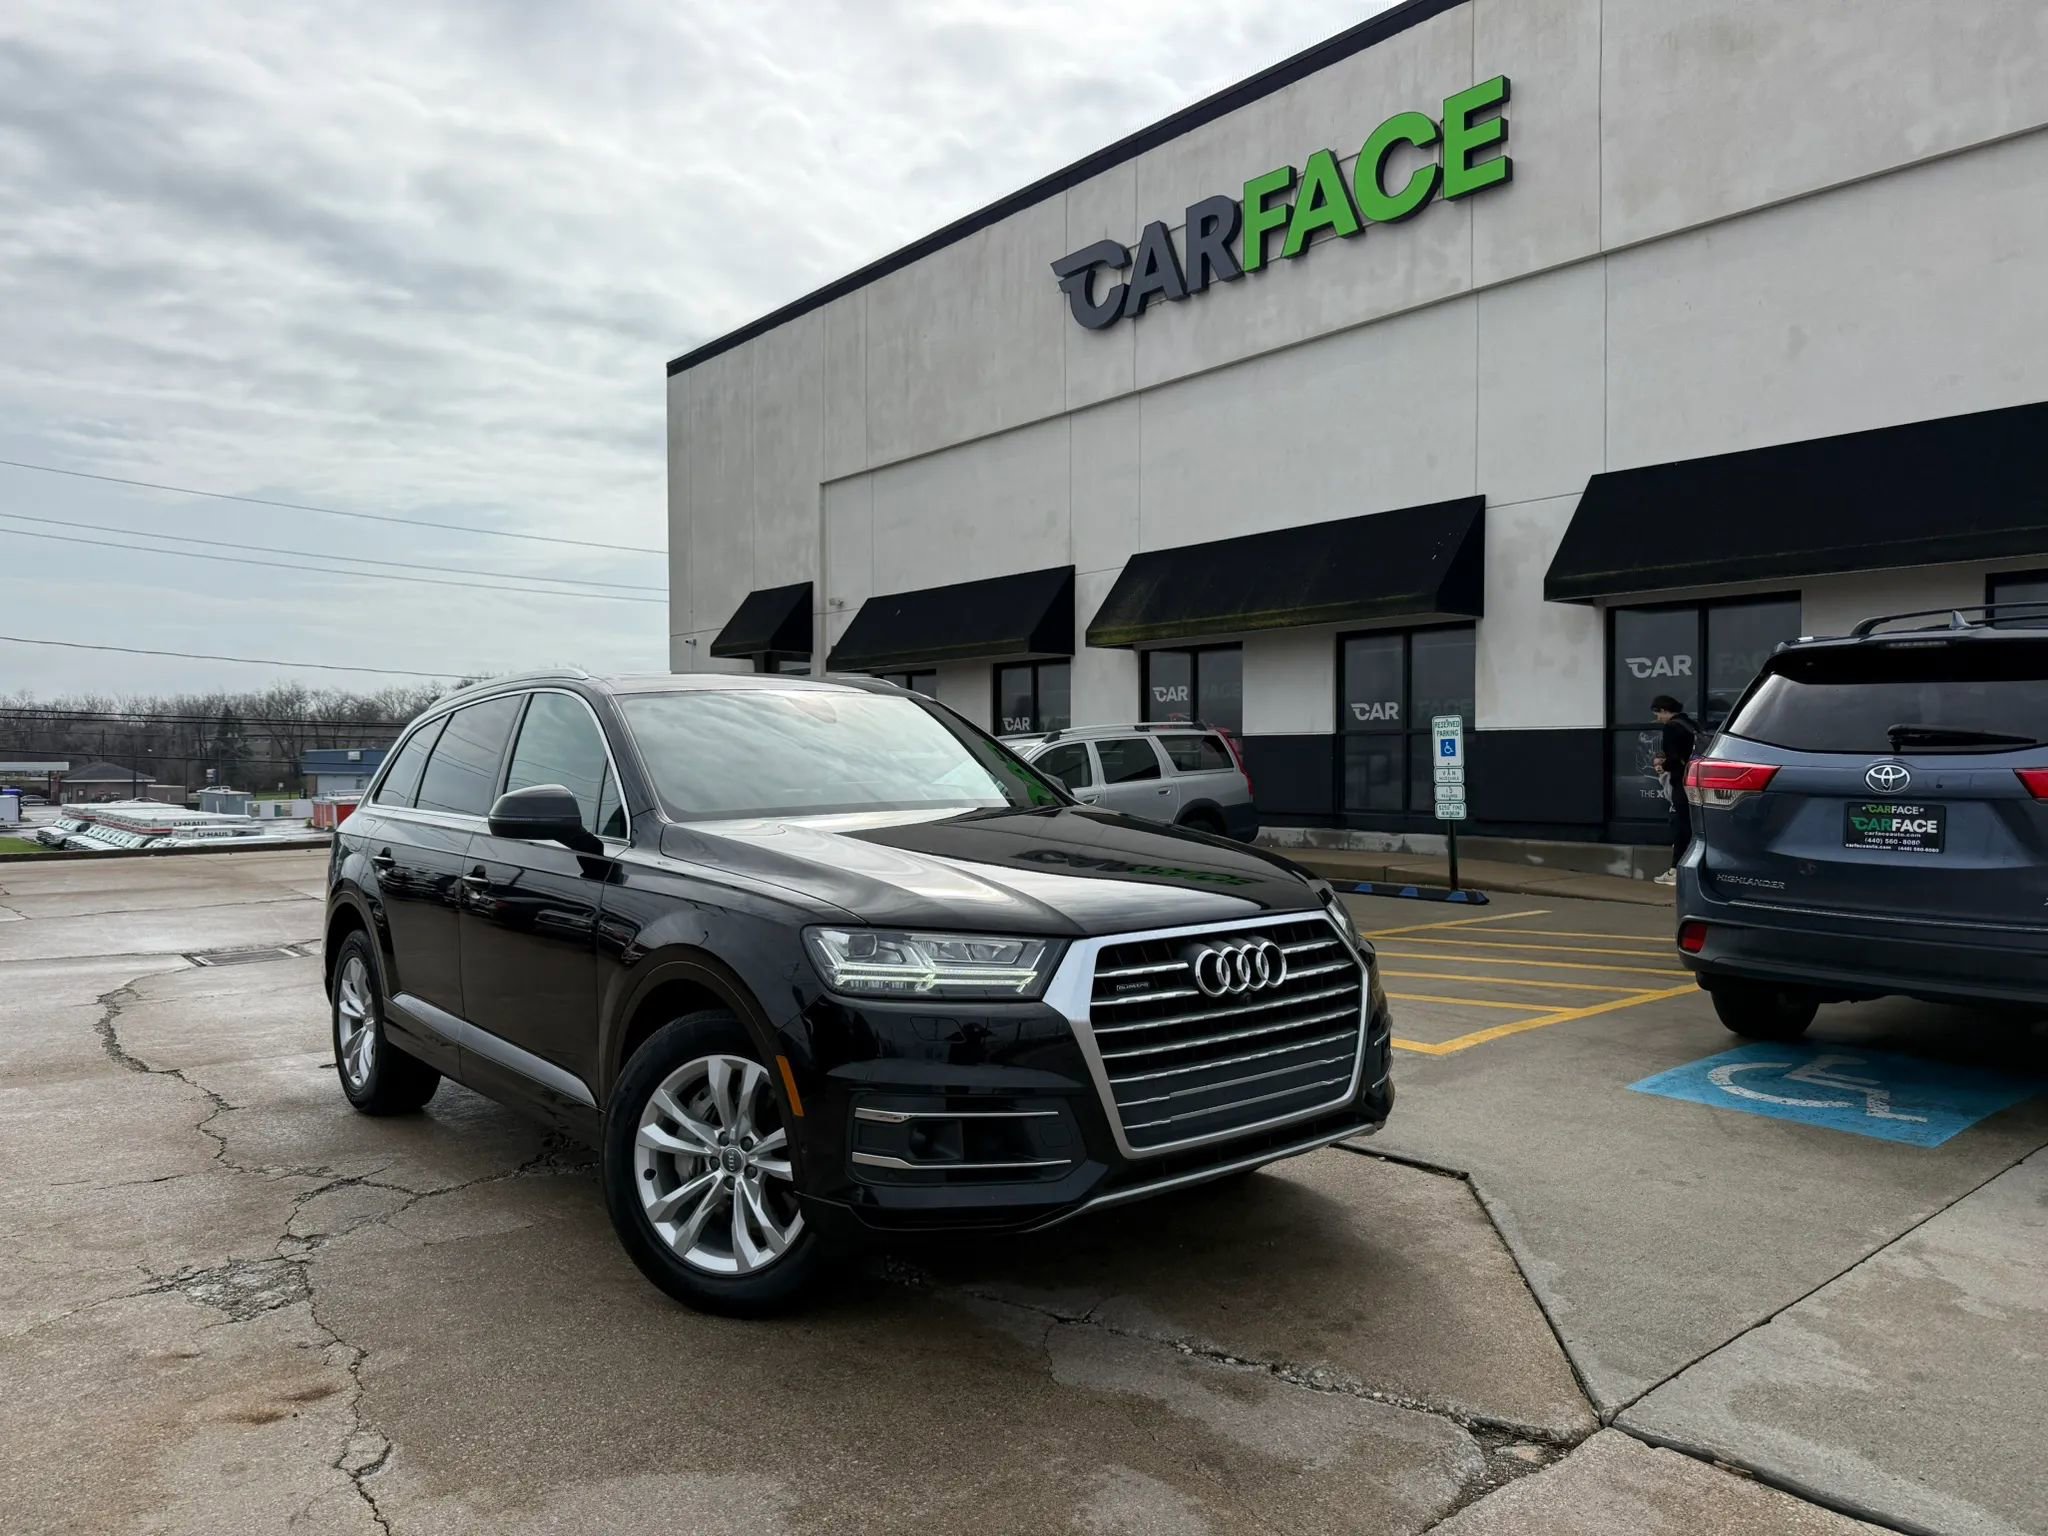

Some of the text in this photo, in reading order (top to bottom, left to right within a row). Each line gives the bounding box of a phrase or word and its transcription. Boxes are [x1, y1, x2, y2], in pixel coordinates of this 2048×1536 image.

[1049, 75, 1512, 330] CARFACE
[1625, 654, 1693, 679] CAR
[1152, 685, 1188, 703] CAR
[1351, 701, 1399, 721] CAR
[1002, 716, 1031, 732] CAR
[1434, 720, 1460, 729] RESERVED
[1640, 789, 1655, 798] THE
[1866, 803, 1919, 815] CARFACE
[1850, 816, 1938, 834] CARFACE
